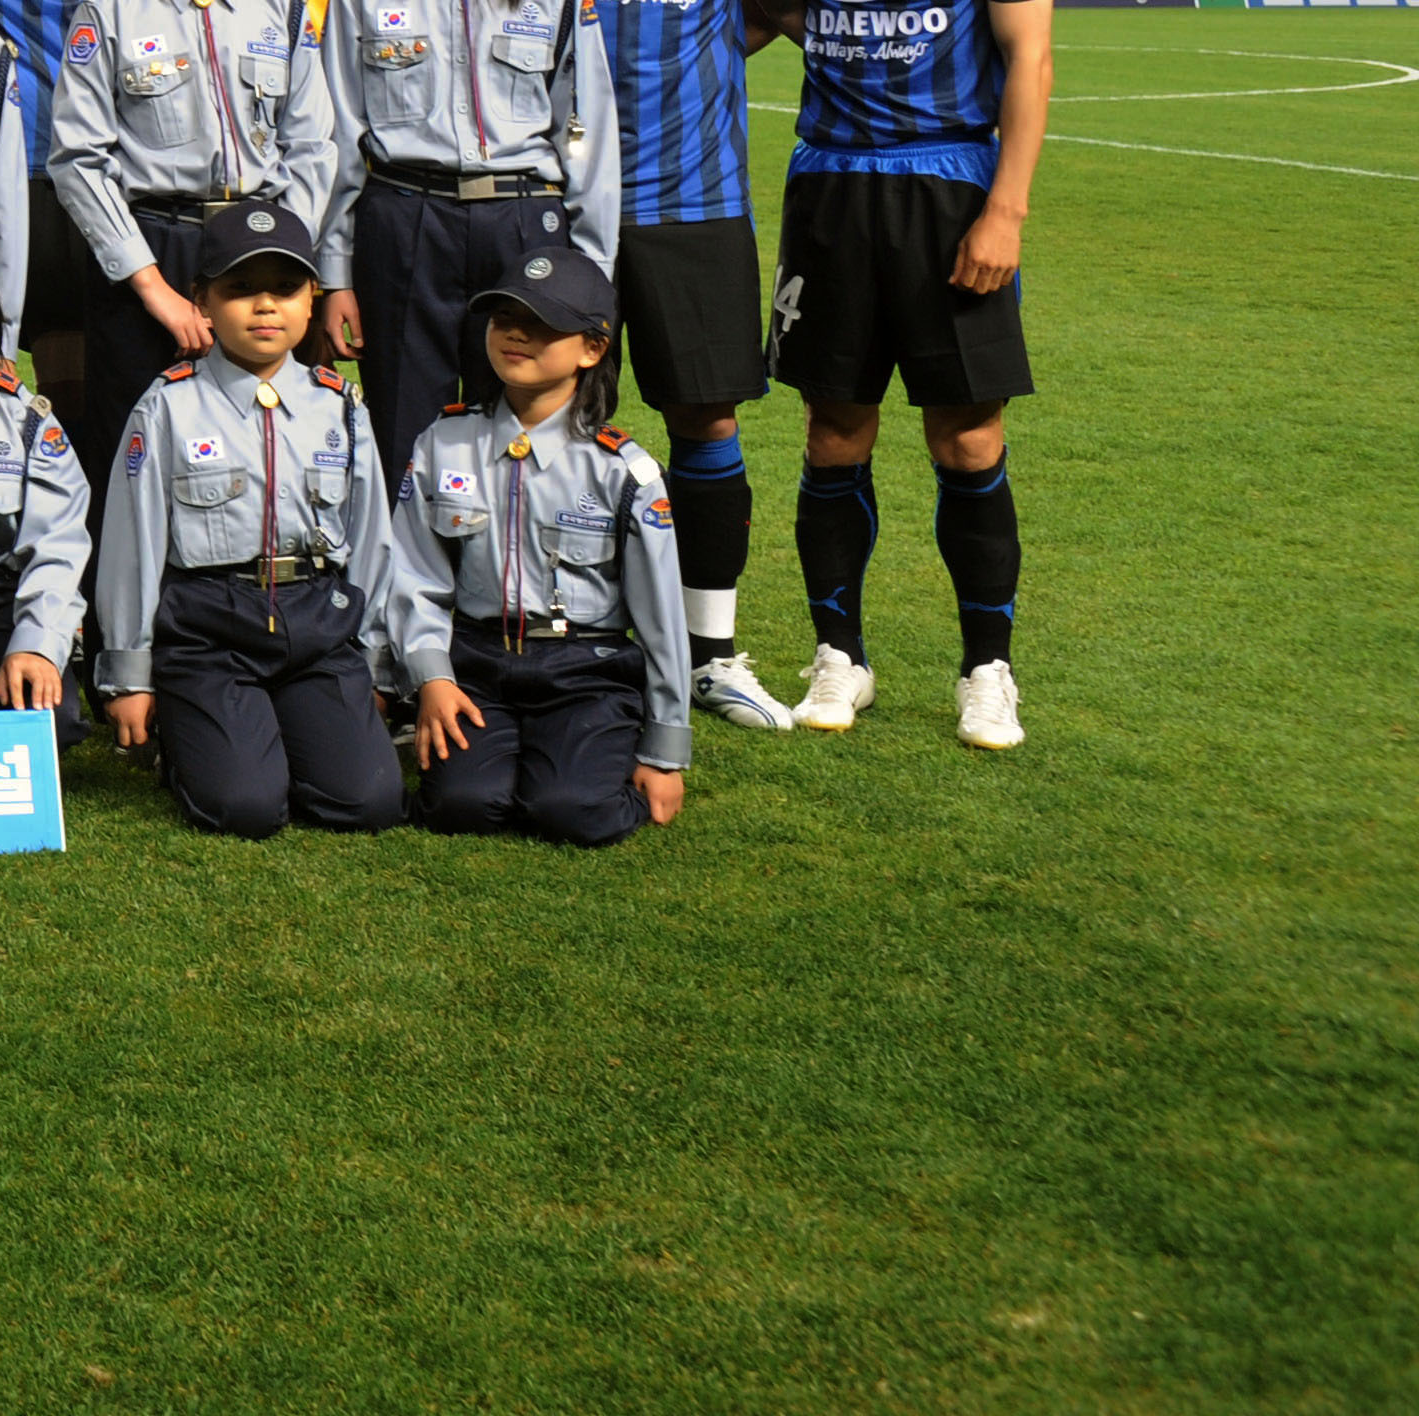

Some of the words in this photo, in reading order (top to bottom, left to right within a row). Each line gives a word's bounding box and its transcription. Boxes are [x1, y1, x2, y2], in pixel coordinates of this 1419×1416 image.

[820, 7, 948, 37] DAEWOO
[825, 40, 868, 63] Ways,
[871, 40, 929, 64] Always
